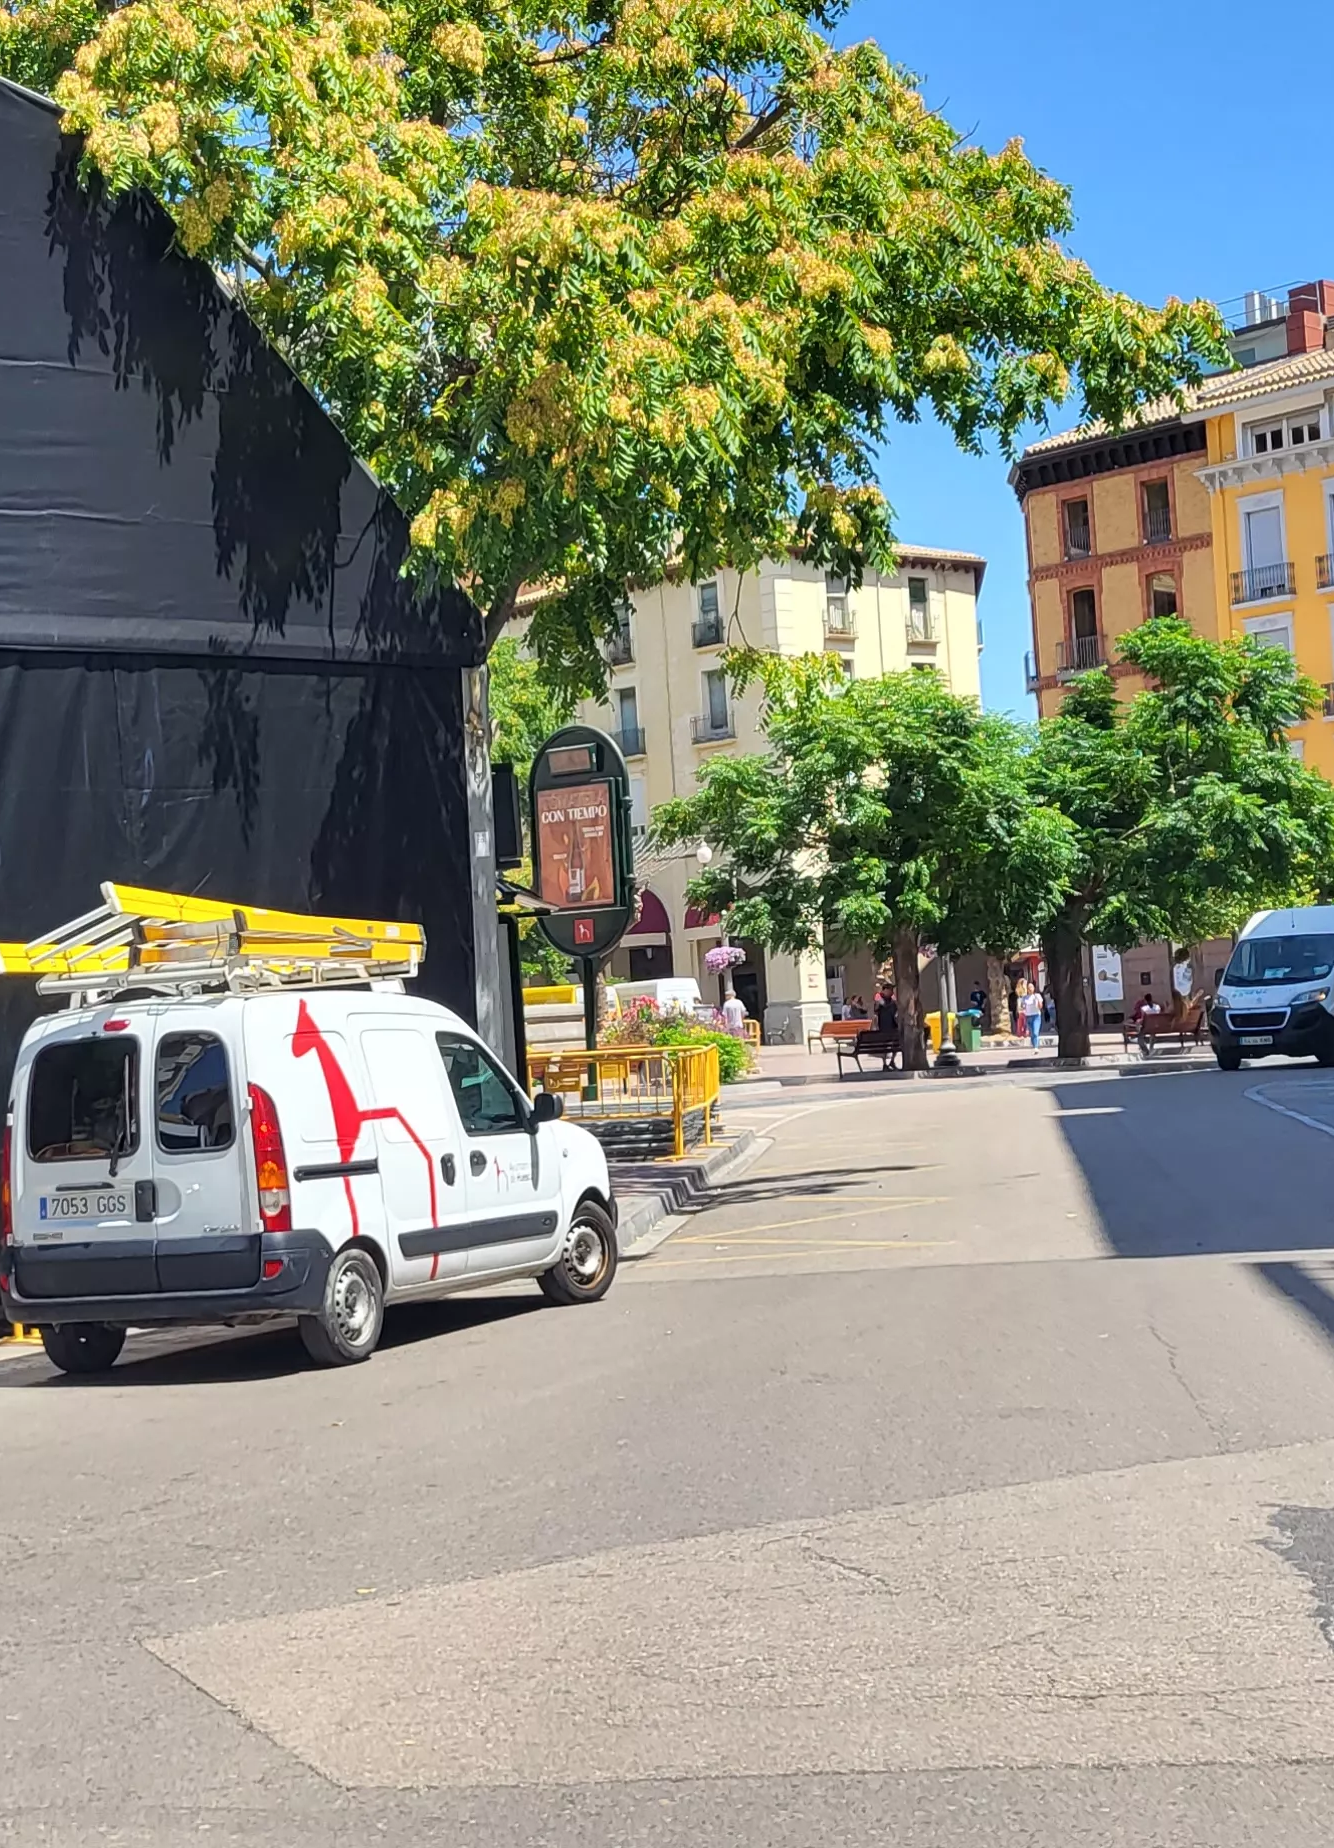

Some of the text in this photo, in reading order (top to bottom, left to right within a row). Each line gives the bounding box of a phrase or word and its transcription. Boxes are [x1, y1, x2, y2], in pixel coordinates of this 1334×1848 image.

[541, 804, 608, 824] CON TIEMPO
[51, 1195, 126, 1217] 7053 GGS
